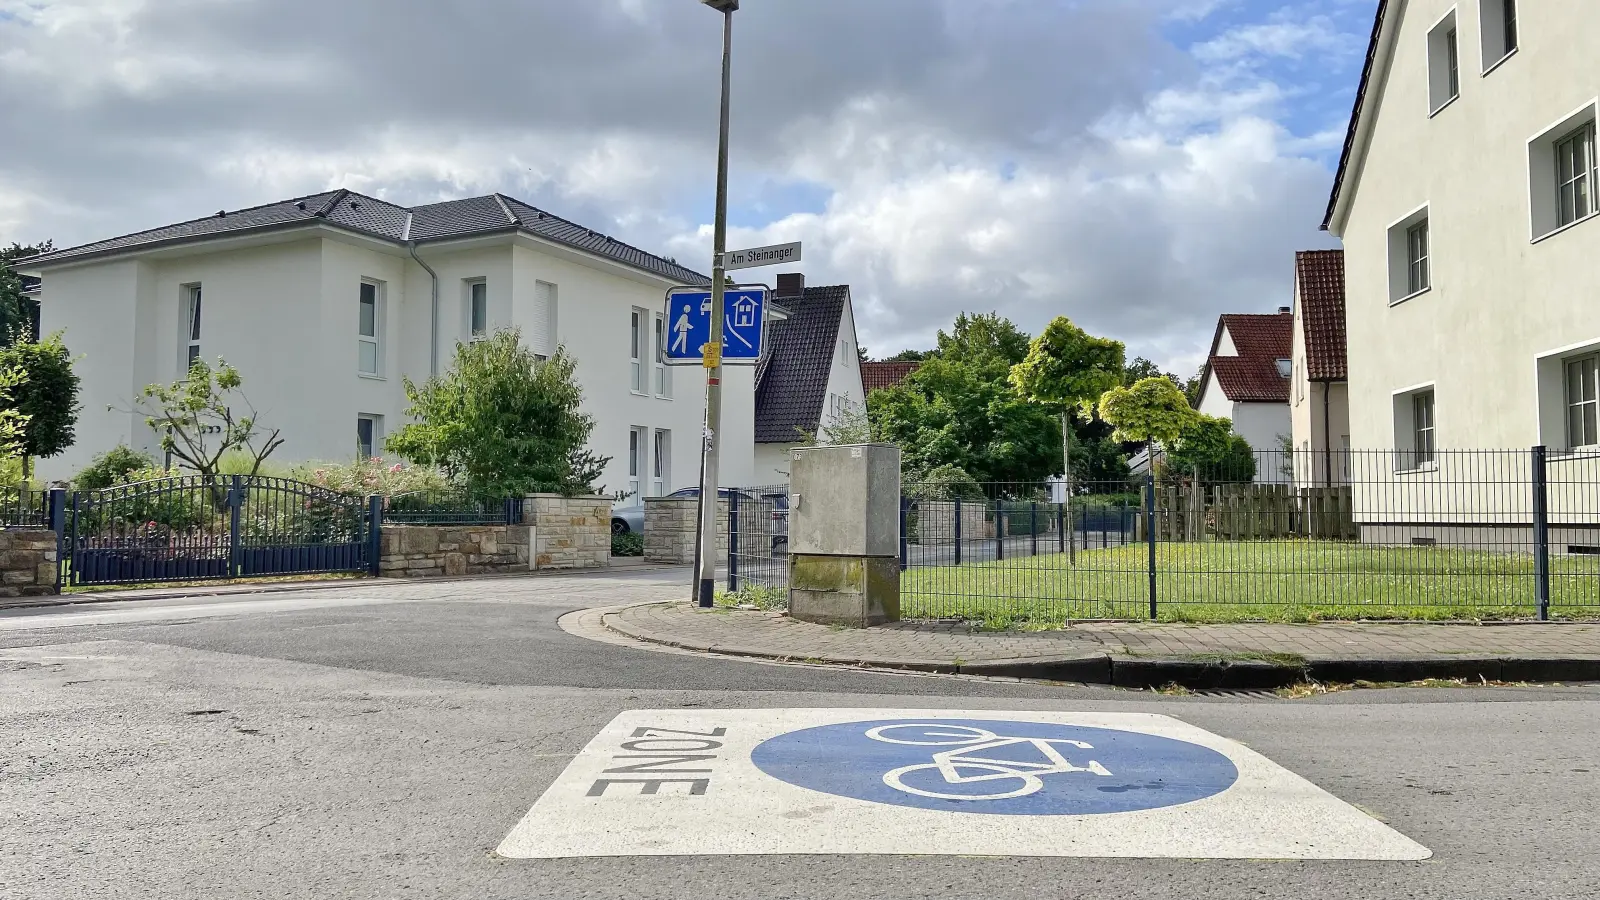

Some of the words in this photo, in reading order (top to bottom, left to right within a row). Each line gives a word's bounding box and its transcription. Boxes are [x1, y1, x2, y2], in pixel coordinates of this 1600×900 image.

[731, 253, 744, 265] Am
[748, 248, 794, 262] Steinanger
[585, 726, 727, 796] ZONE
